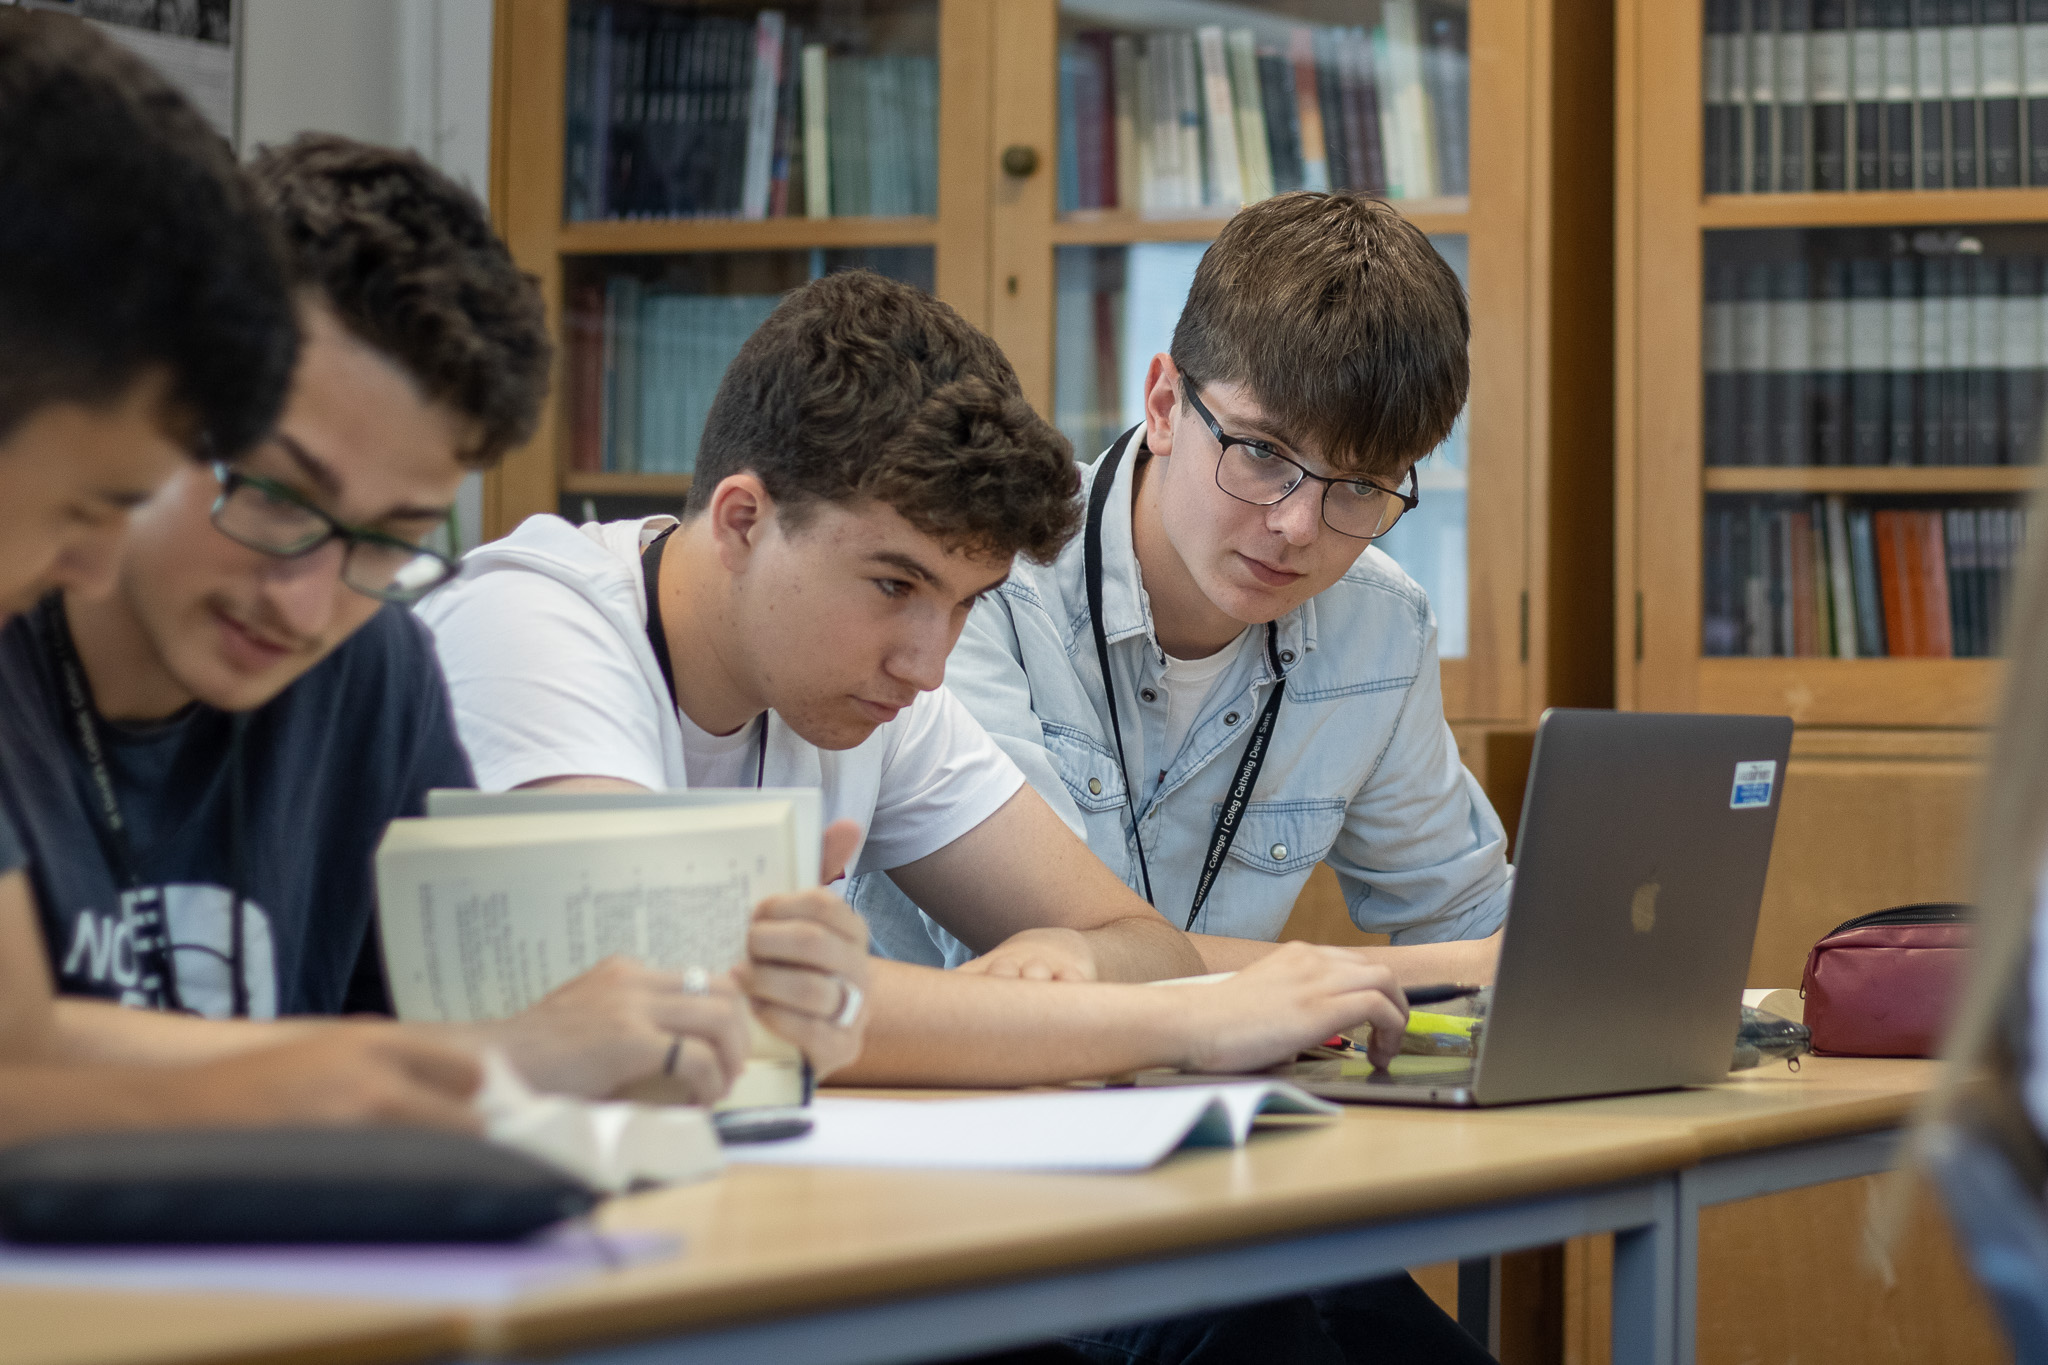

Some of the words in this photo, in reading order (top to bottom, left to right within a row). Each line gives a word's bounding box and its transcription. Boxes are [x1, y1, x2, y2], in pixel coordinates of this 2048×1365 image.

[1195, 870, 1212, 907] Catholic
[1209, 834, 1226, 869] College
[1224, 799, 1241, 826] Coleg
[1234, 760, 1257, 798] Catholig
[1249, 736, 1264, 758] Dewi
[1259, 712, 1272, 733] Sant
